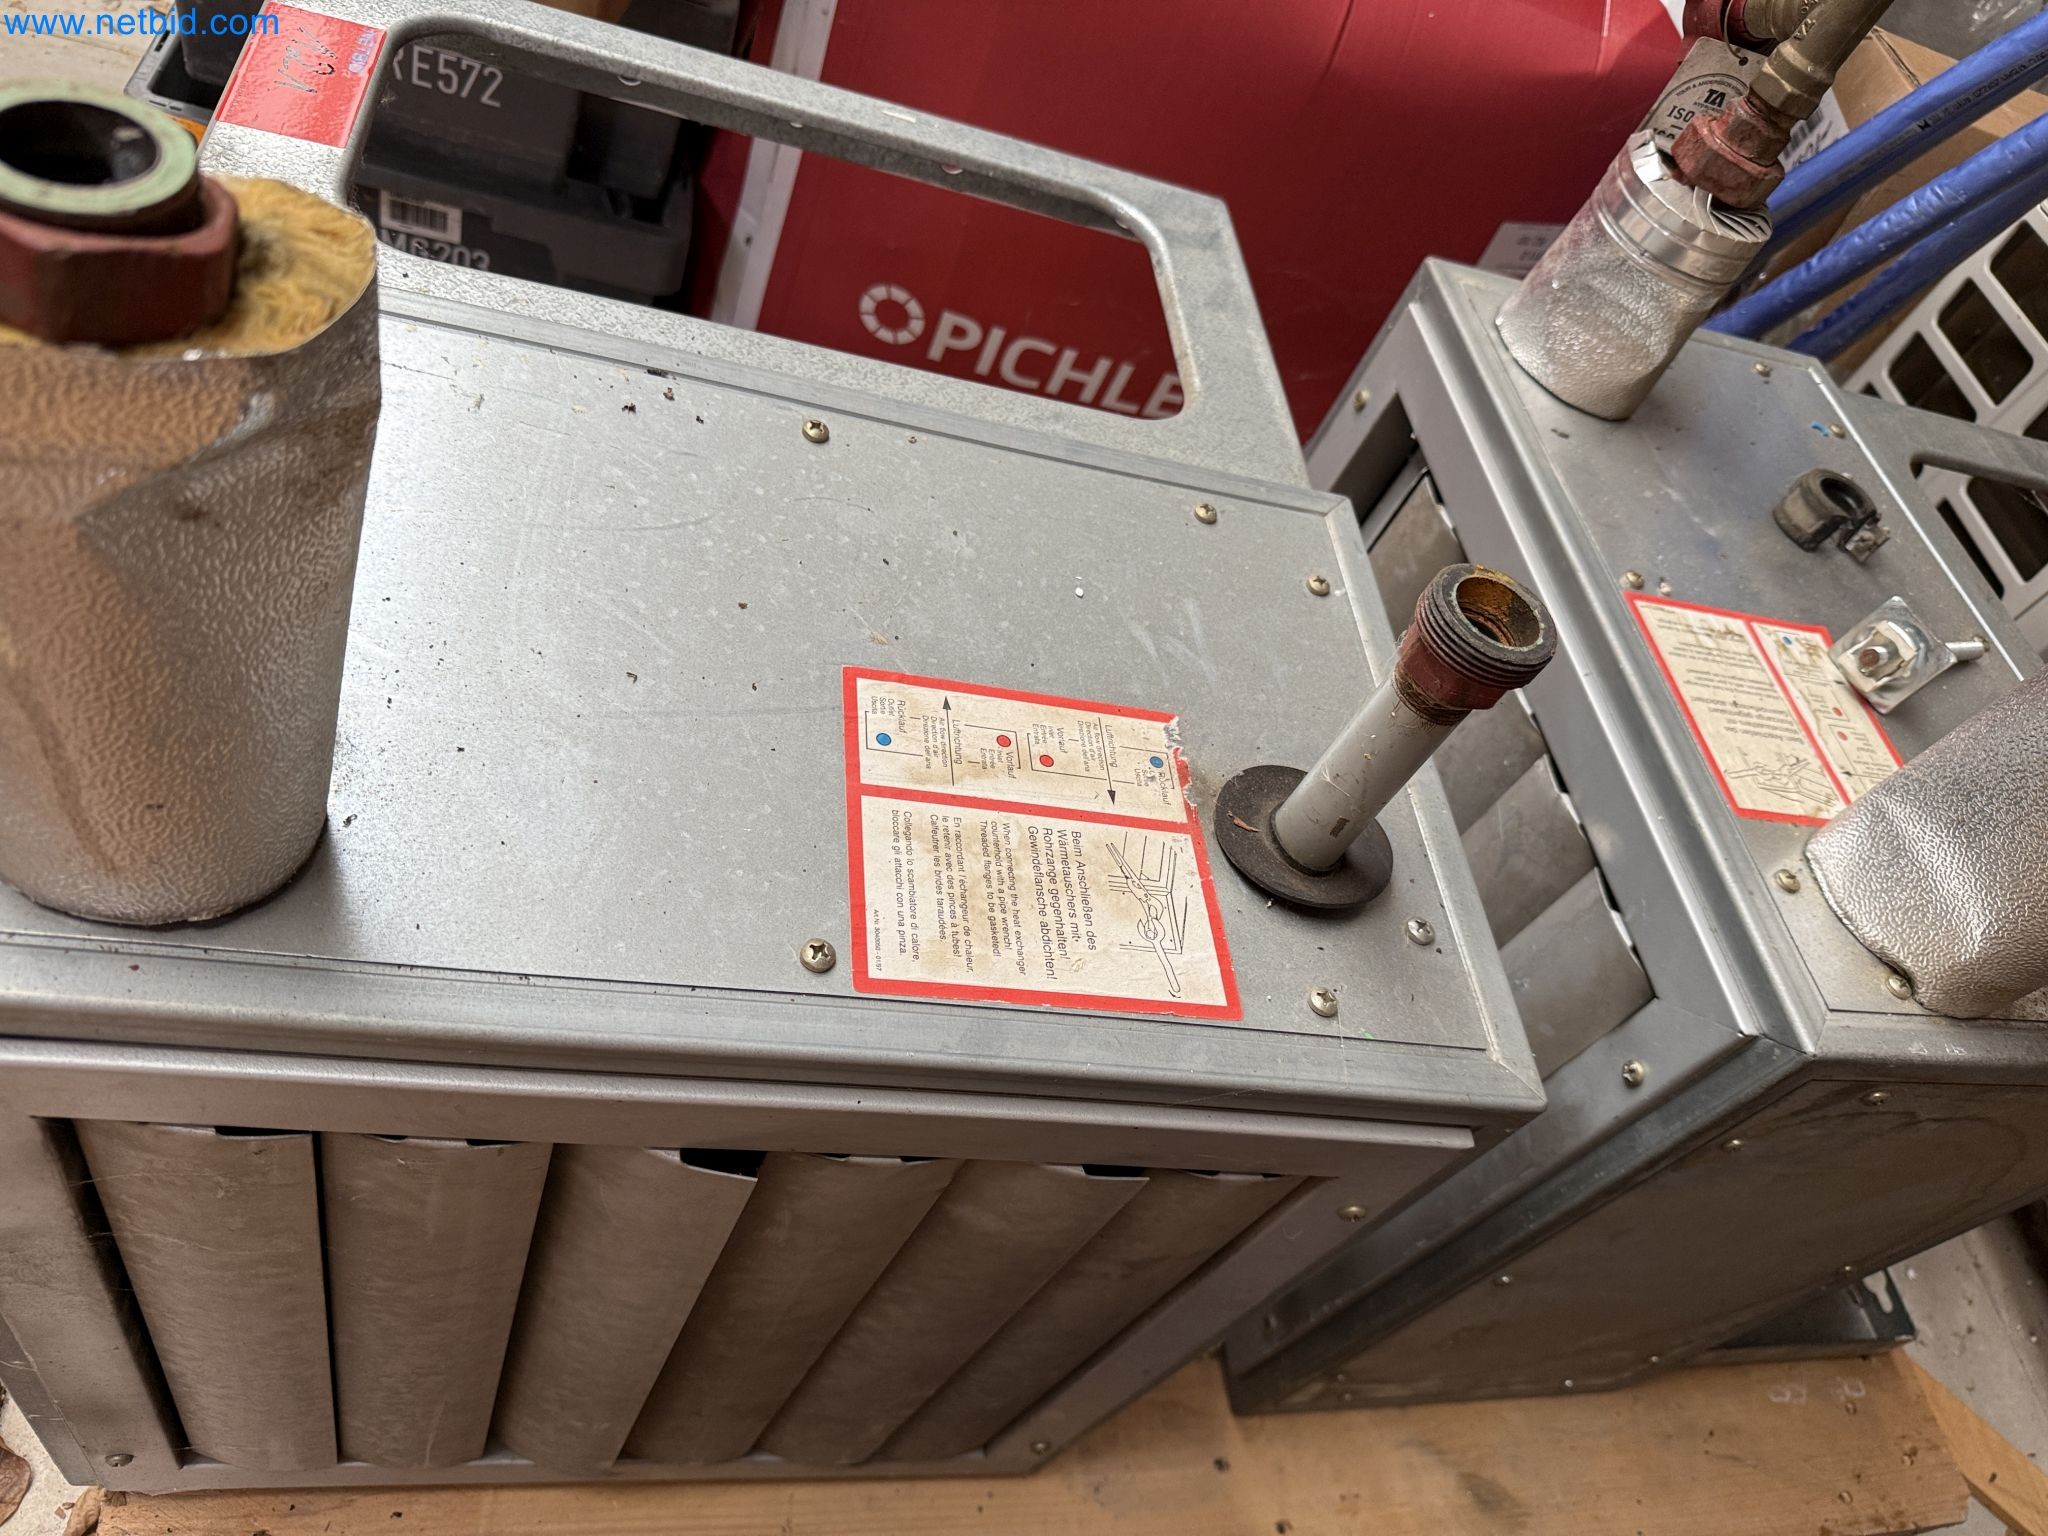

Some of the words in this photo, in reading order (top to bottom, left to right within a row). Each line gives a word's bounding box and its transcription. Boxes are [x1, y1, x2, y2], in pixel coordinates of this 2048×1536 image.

[1703, 88, 1727, 109] TA
[897, 699, 907, 734] Rücklauf
[930, 716, 939, 743] Direction
[952, 719, 963, 765] Luftrichtung
[1056, 727, 1068, 754] Vorlauf
[1105, 724, 1118, 768] Luftrichtung
[940, 741, 949, 768] direction
[1005, 751, 1016, 780] Vorlauf
[1096, 745, 1105, 771] direction
[891, 809, 901, 844] bloccare
[941, 815, 949, 823] le
[953, 816, 962, 828] En
[902, 811, 914, 856] Collegando
[930, 814, 940, 853] Calfeutrer
[942, 824, 952, 850] retenir
[980, 820, 991, 858] Threaded
[990, 820, 1003, 867] counterhold
[1002, 822, 1012, 845] When
[1071, 830, 1084, 858] Beim
[891, 845, 903, 856] gli
[906, 858, 916, 867] lo
[933, 855, 942, 868] les
[944, 852, 953, 872] avec
[954, 830, 966, 873] raccordant
[1042, 827, 1058, 885] Rohrzange
[894, 857, 905, 890] attacchi
[934, 869, 944, 896] brides
[946, 874, 955, 890] des
[982, 859, 993, 890] flanges
[996, 869, 1005, 886] with
[1005, 847, 1017, 892] connecting
[1057, 829, 1077, 919] Wärmetauschers
[895, 892, 904, 908] con
[907, 868, 918, 920] scambiatore
[946, 892, 958, 920] pinces
[986, 891, 995, 900] to
[996, 896, 1008, 914] pipe
[1010, 893, 1020, 907] the
[1027, 825, 1048, 917] Gewindeflansche
[1039, 920, 1058, 980] abdichten!
[1075, 860, 1094, 927] Anschließen
[897, 910, 905, 927] una
[987, 902, 997, 914] be
[1012, 909, 1022, 928] heat
[910, 922, 920, 931] di
[962, 925, 972, 937] de
[987, 915, 1002, 957] gasketed!
[1001, 916, 1013, 951] wrench!
[1047, 888, 1071, 960] gegenhalten!
[951, 930, 961, 958] tubes!
[1014, 930, 1027, 976] exchanger
[1085, 930, 1098, 951] des
[964, 939, 975, 973] chaleur,
